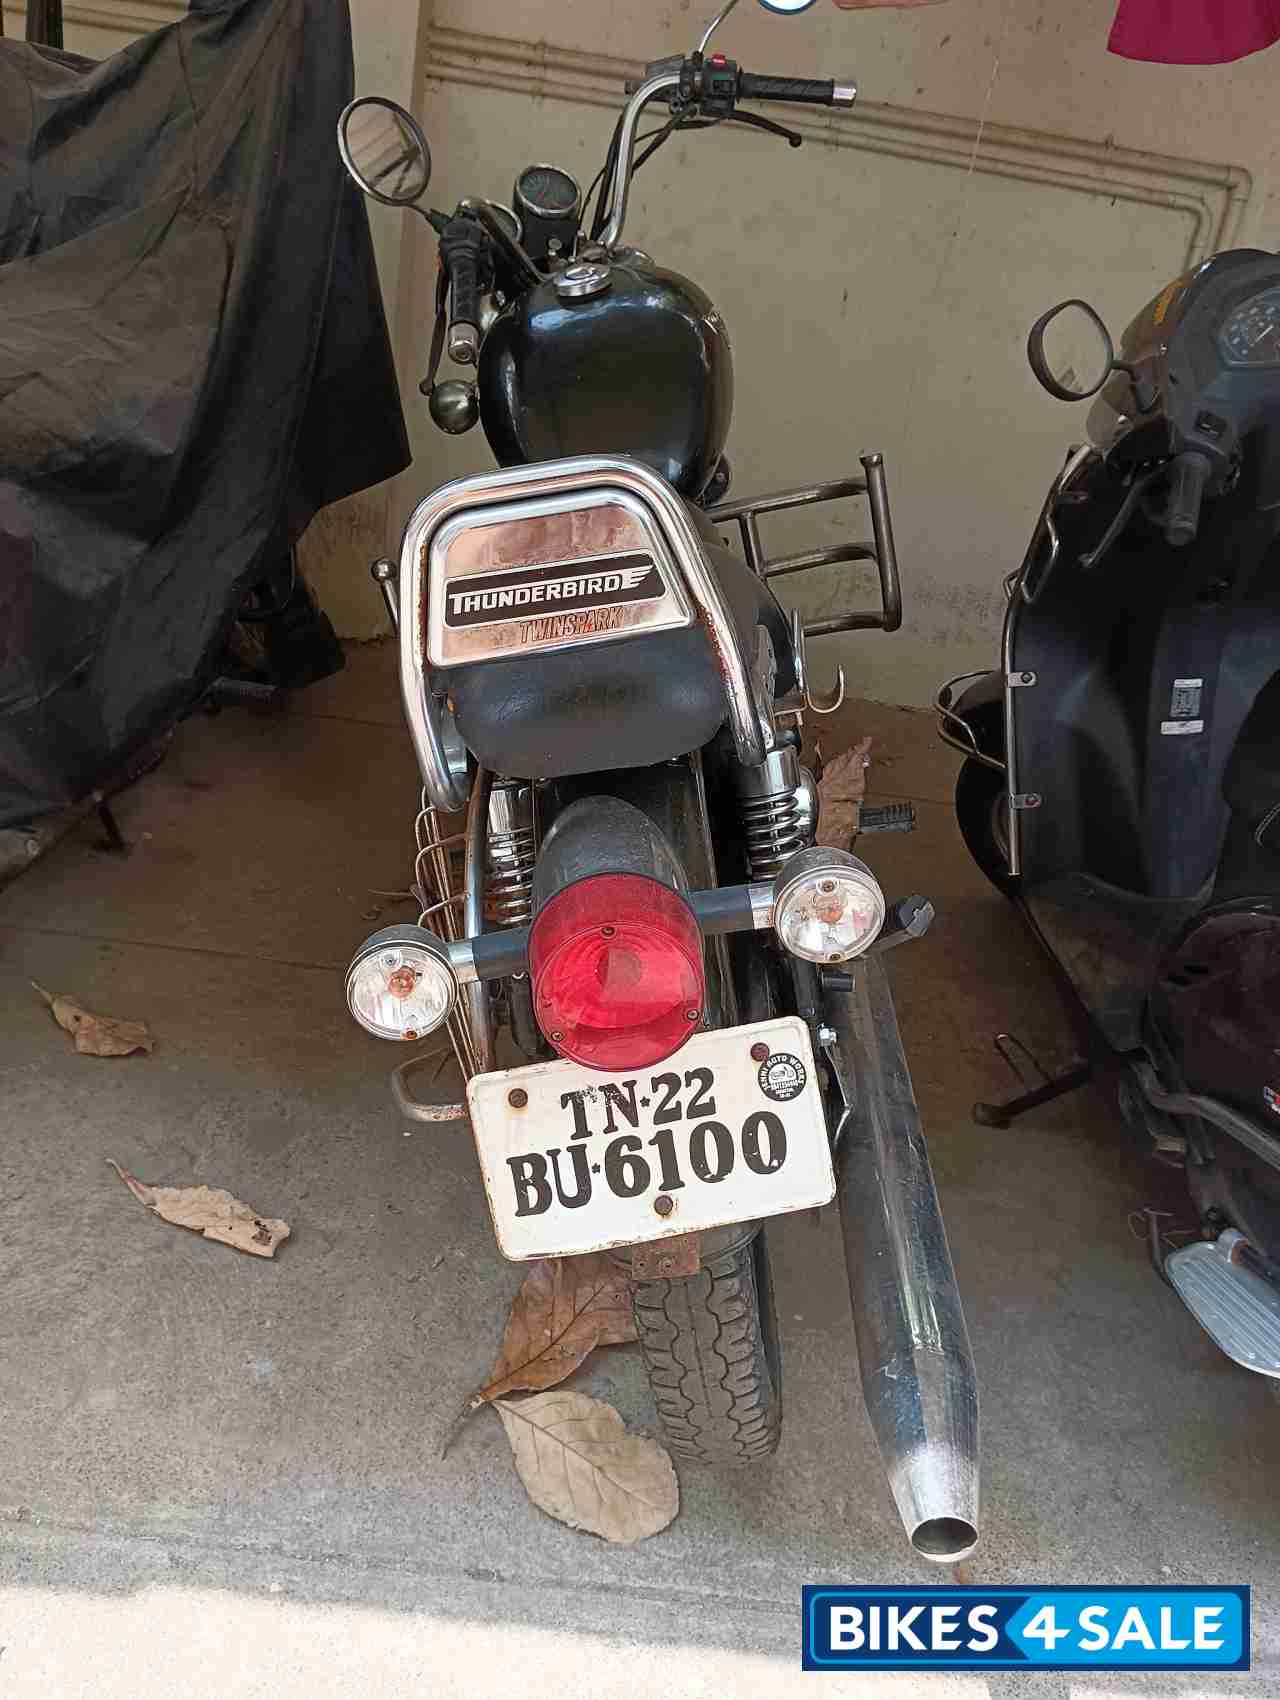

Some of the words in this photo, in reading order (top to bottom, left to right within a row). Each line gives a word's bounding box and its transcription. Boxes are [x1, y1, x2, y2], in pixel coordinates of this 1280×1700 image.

[449, 570, 628, 614] THUNDERBIRD
[520, 607, 624, 643] TWINSPARK
[767, 1055, 787, 1068] AUTO
